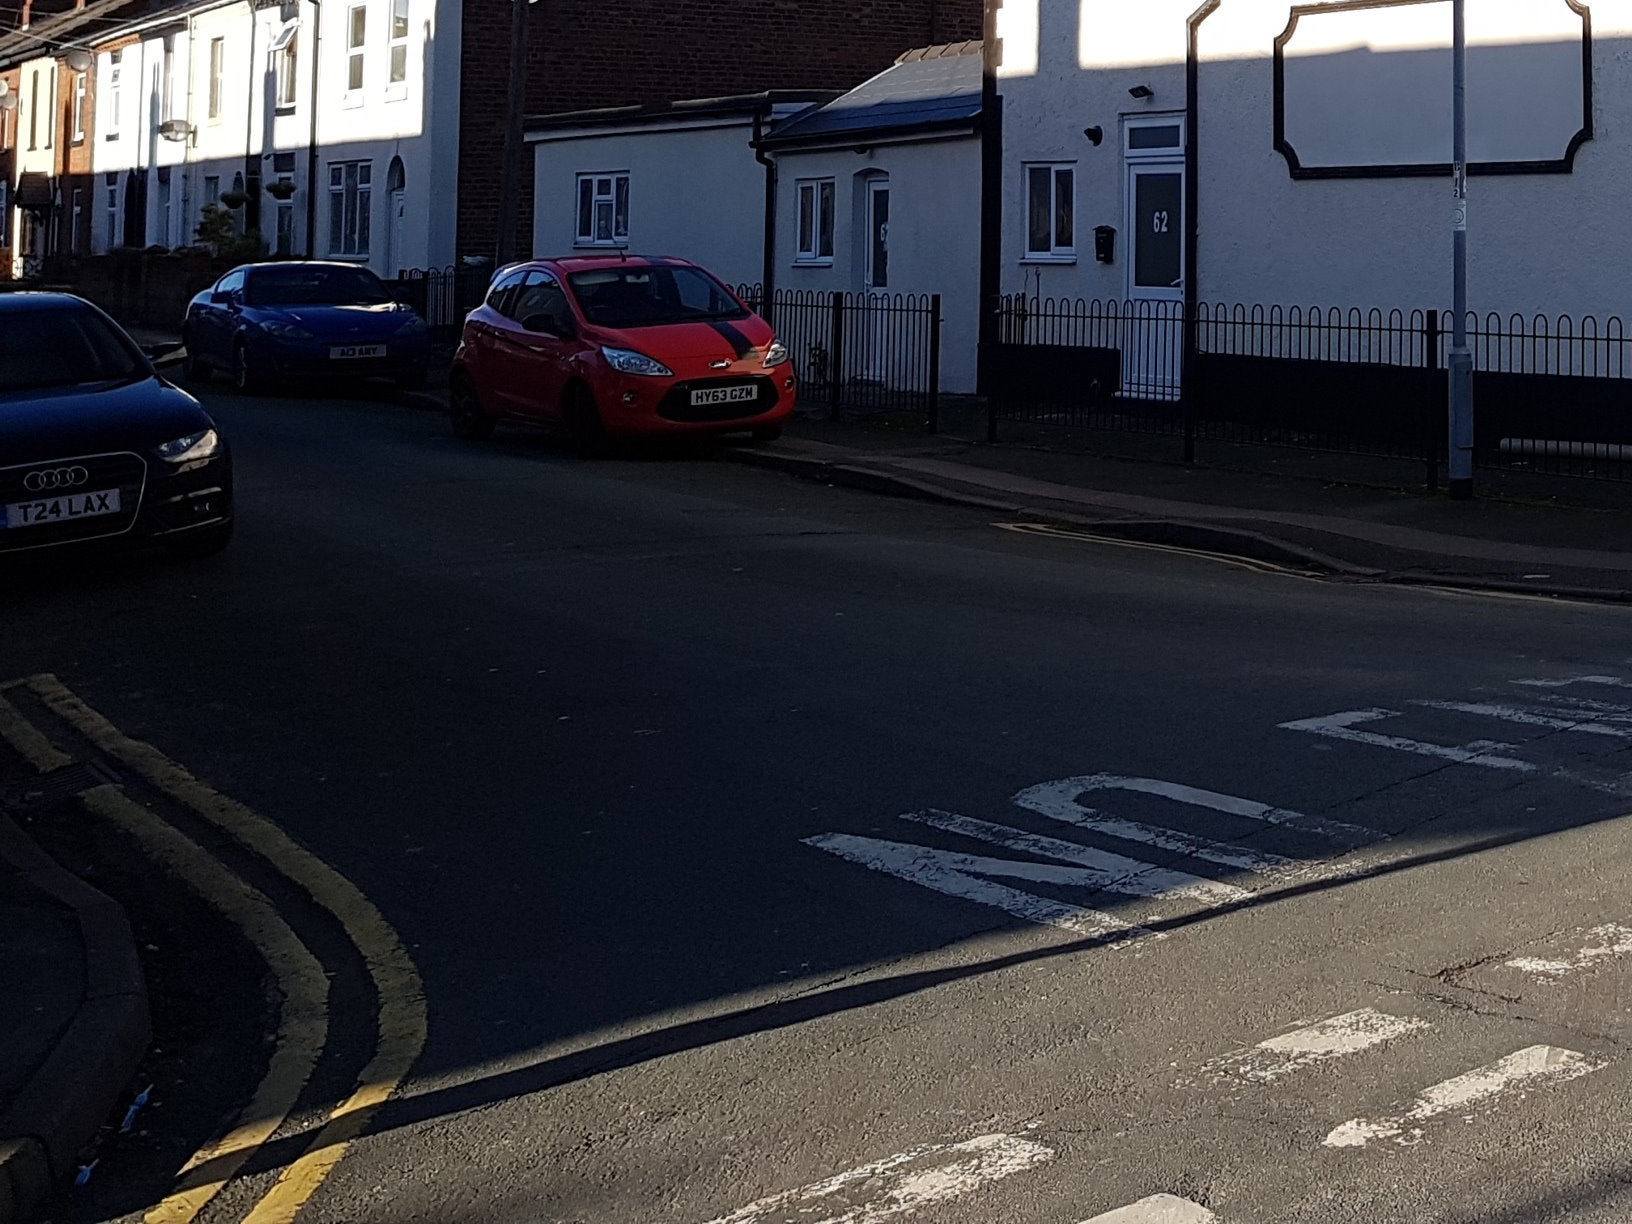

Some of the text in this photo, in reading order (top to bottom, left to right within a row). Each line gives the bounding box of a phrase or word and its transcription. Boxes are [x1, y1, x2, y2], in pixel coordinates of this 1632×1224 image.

[1153, 211, 1168, 233] 62
[695, 389, 728, 404] HY63
[18, 493, 110, 522] T24 LAX
